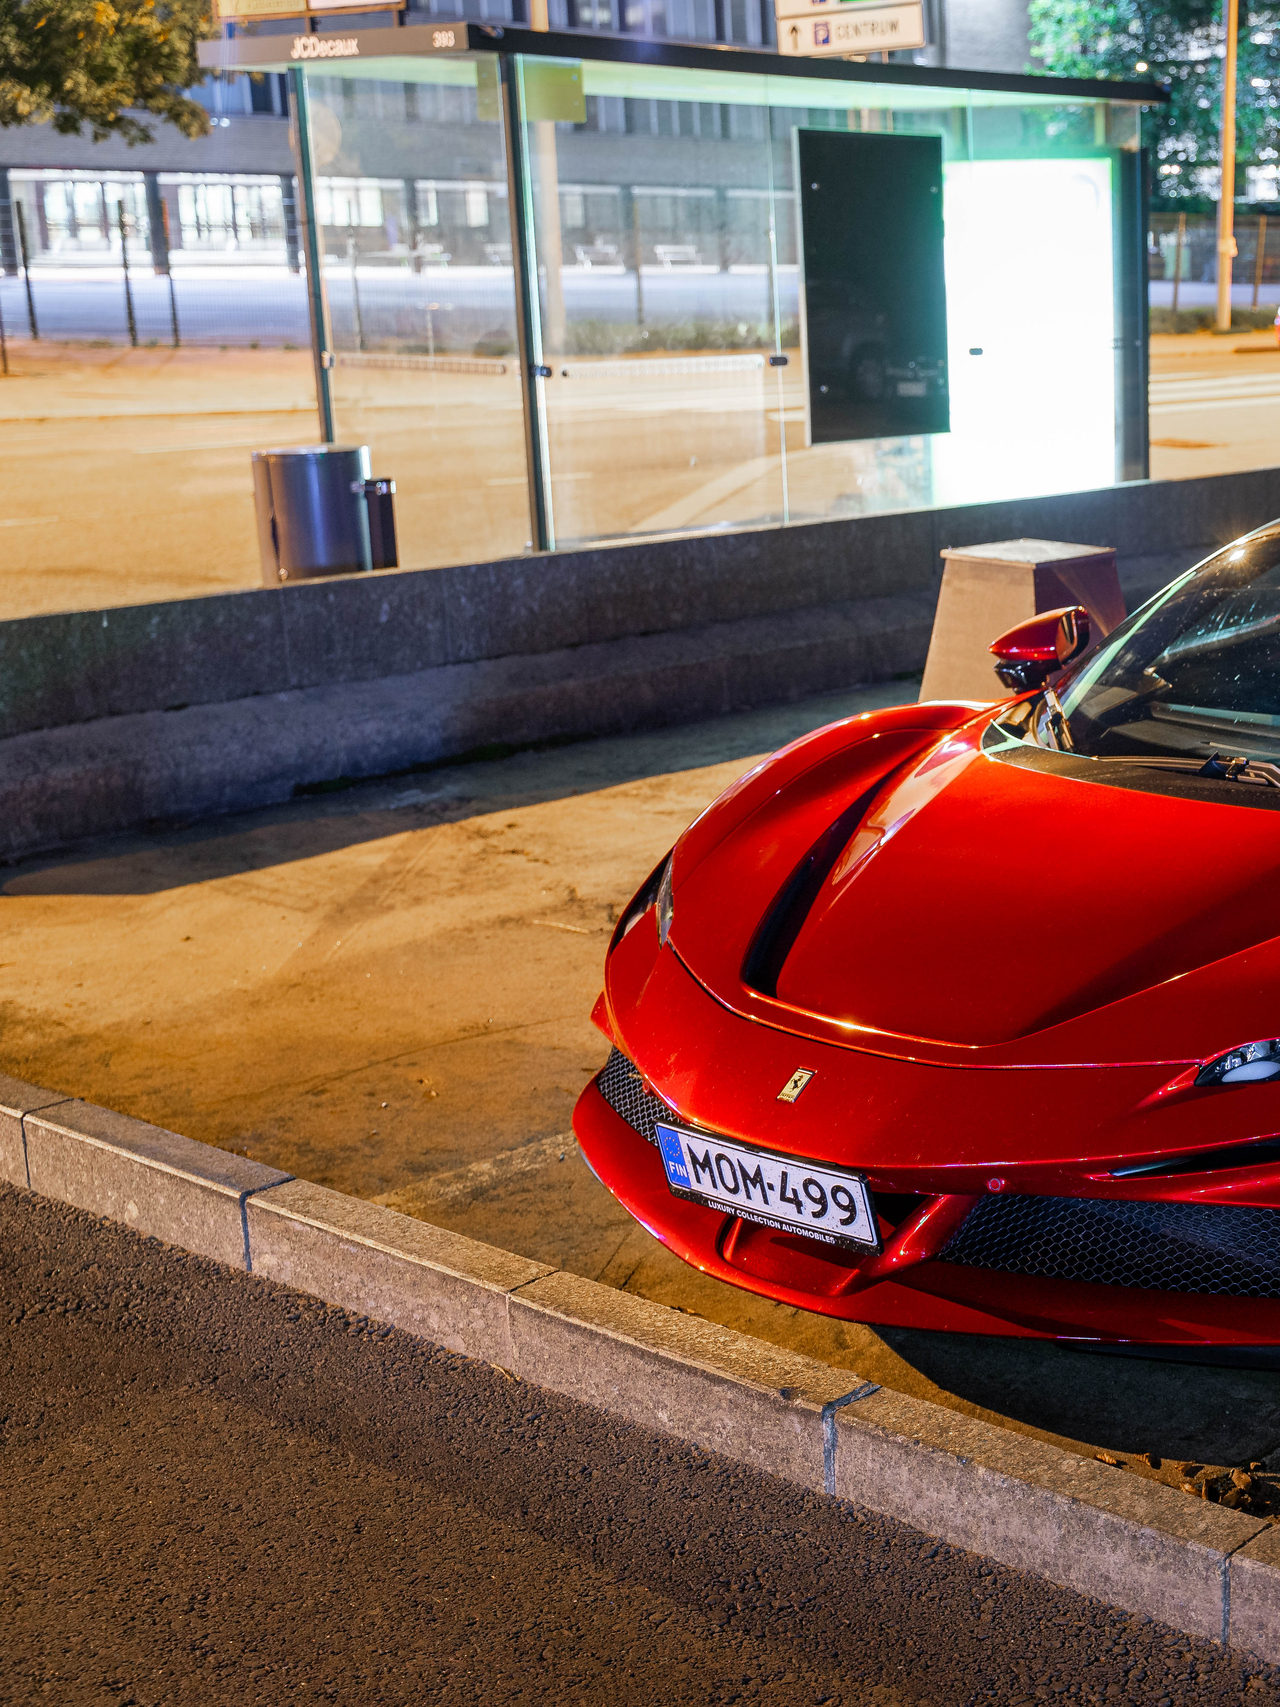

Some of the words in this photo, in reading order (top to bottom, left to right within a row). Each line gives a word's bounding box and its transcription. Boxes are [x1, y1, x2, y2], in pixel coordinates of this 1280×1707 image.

[835, 19, 900, 41] CENTRUM
[291, 36, 360, 60] JCDecaux
[669, 1160, 689, 1178] FIN
[686, 1142, 858, 1227] MOM-499
[707, 1200, 735, 1216] LUXURY
[736, 1209, 781, 1230] COLLECTION
[782, 1221, 836, 1245] AUTOMOBILES
